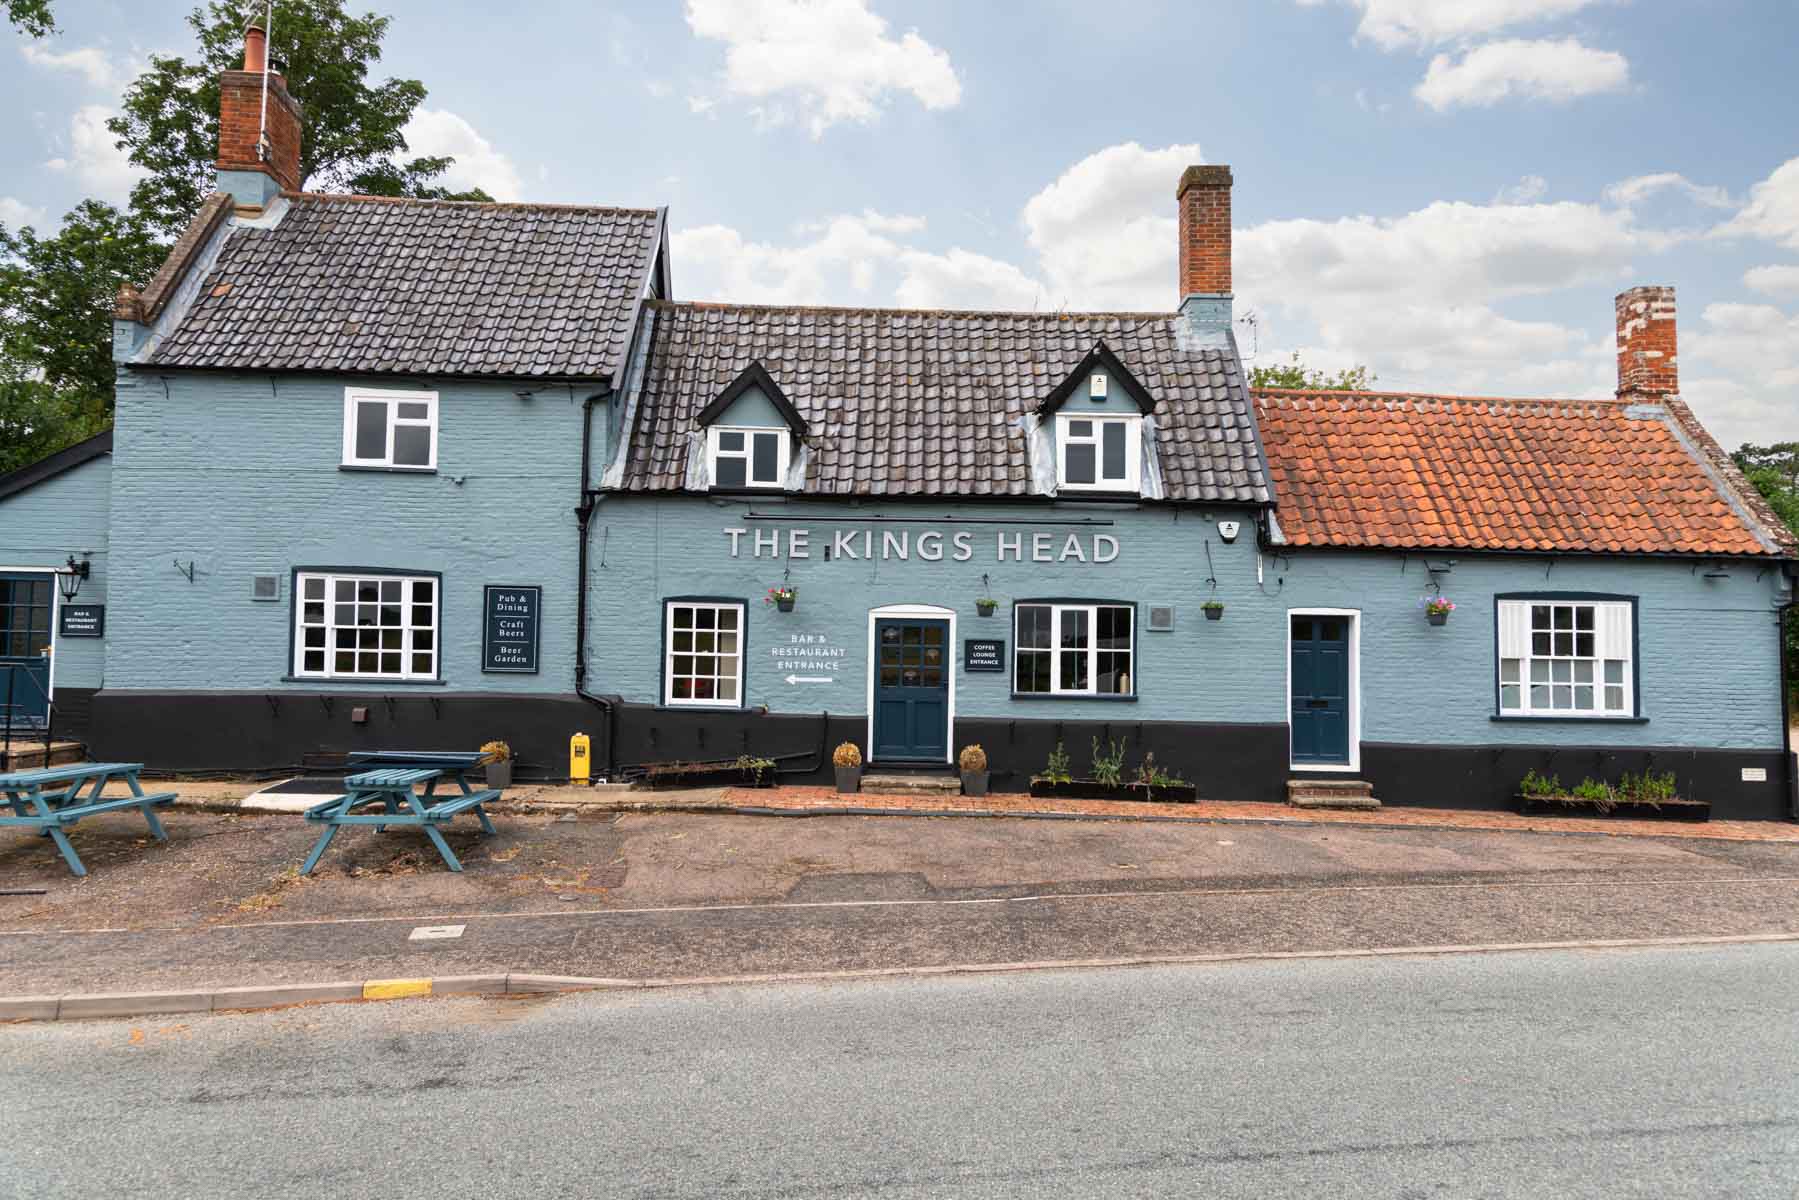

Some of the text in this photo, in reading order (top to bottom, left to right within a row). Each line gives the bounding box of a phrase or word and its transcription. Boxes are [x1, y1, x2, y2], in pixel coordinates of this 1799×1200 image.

[723, 528, 1120, 563] THE KINGS HEAD
[499, 594, 516, 602] Pub
[497, 603, 528, 613] Dining
[500, 620, 524, 628] Craft
[499, 629, 524, 637] Beers
[791, 634, 814, 644] BAR
[501, 646, 521, 654] Beer
[771, 647, 846, 656] RESTAURANT
[494, 655, 527, 663] Garden
[777, 661, 839, 670] ENTRANCE
